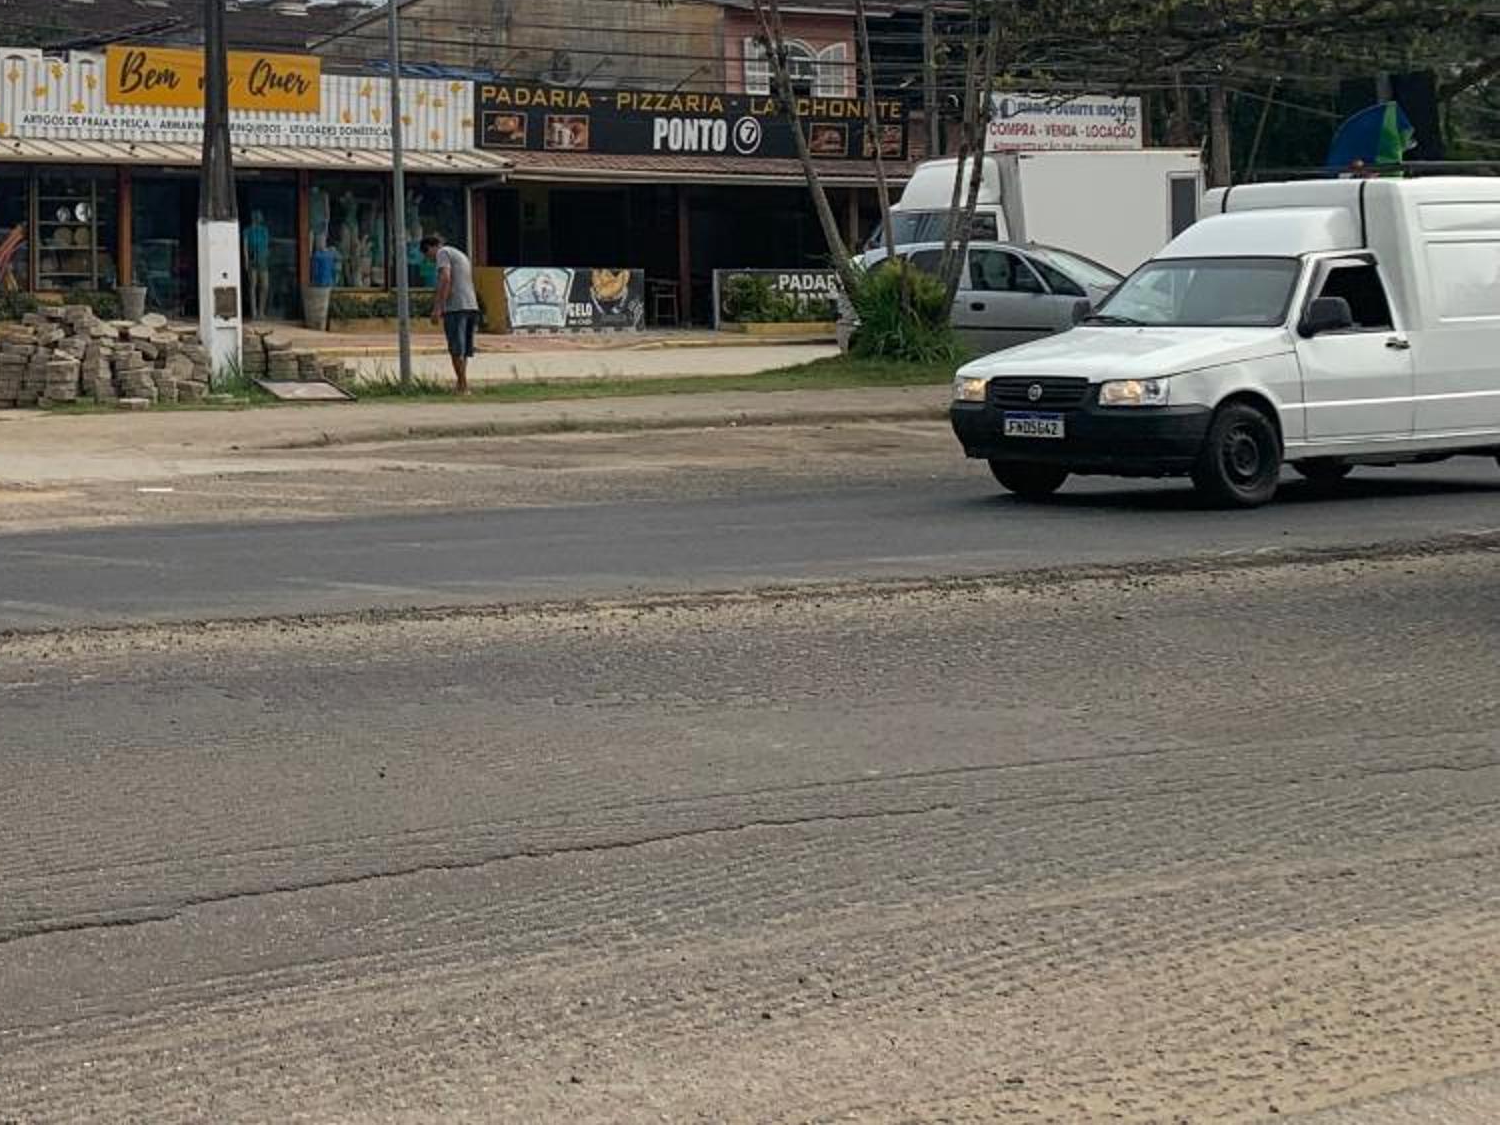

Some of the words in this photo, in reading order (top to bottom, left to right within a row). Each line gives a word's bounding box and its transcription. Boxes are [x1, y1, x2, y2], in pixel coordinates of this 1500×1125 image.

[120, 51, 181, 94] Bem
[248, 58, 311, 97] Quer
[481, 85, 591, 109] PADARIA
[616, 91, 724, 114] PIZZARIA
[750, 97, 902, 119] LACHONTE
[67, 116, 79, 127] DE
[989, 123, 1036, 136] COMPRA
[652, 117, 727, 152] PONTO
[779, 274, 840, 291] PADAR
